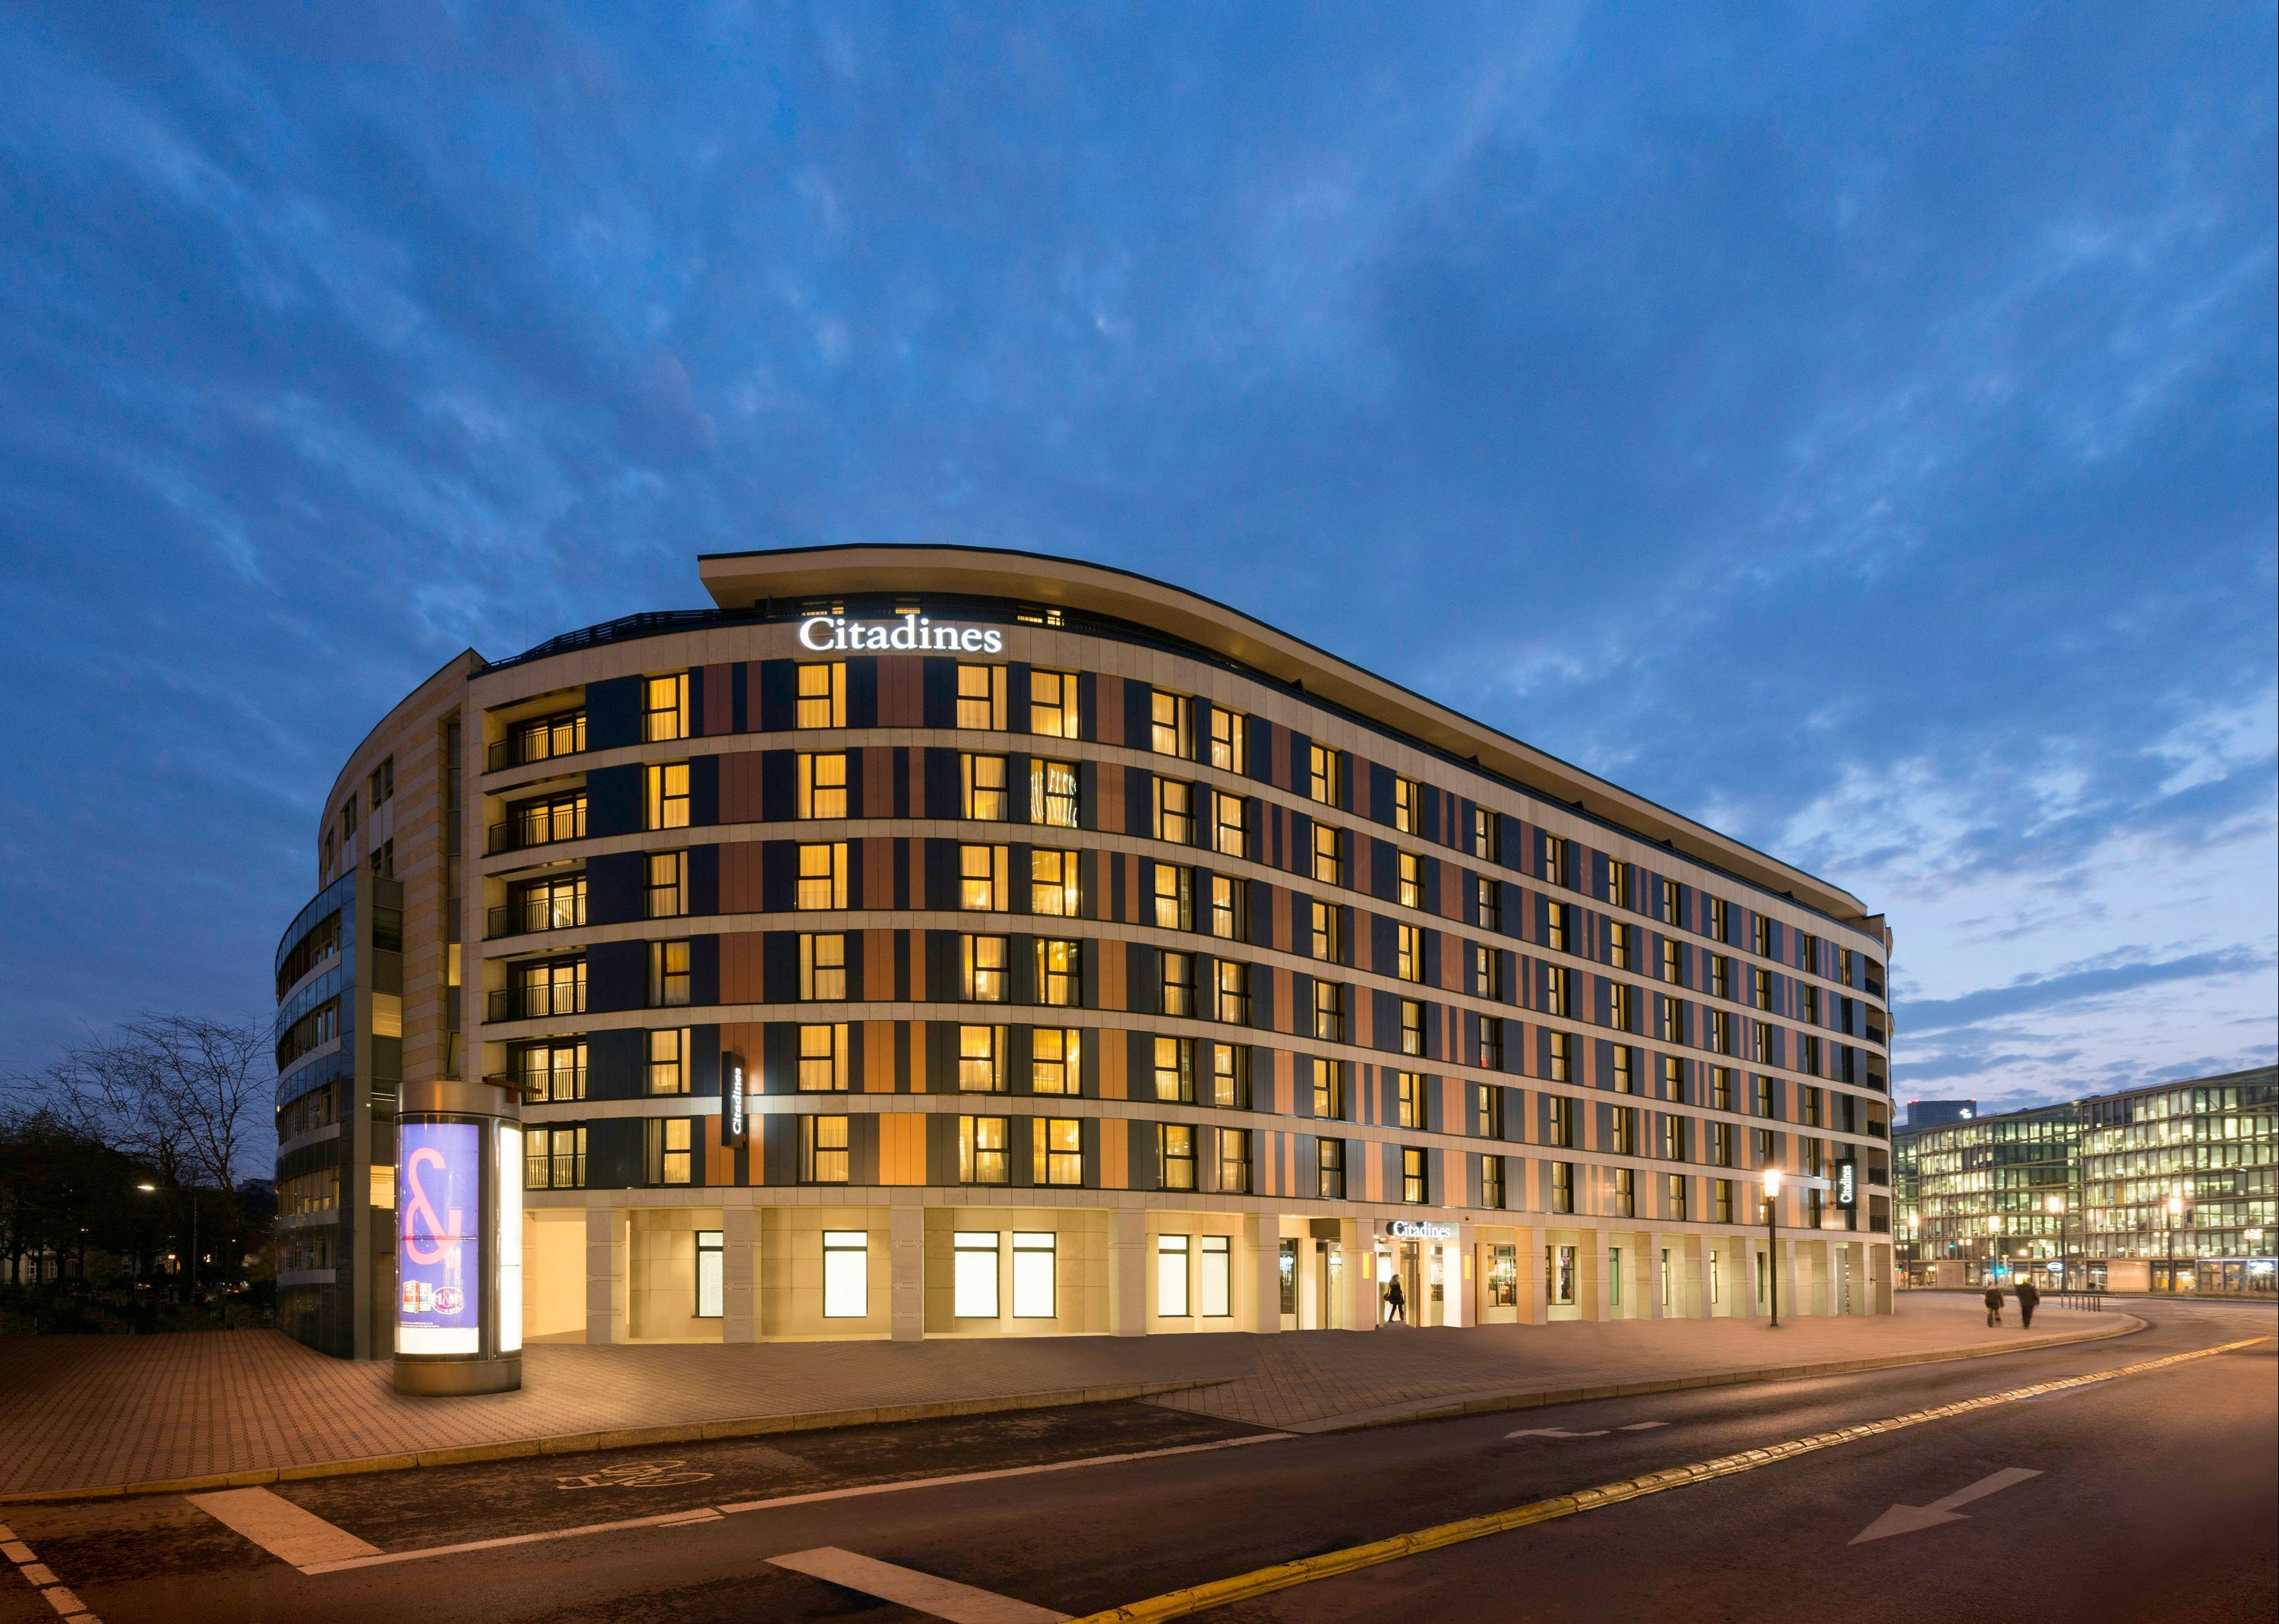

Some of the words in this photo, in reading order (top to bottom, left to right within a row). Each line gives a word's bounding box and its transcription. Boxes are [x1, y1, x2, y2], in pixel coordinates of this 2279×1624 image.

[799, 614, 1003, 654] Citadines
[732, 1066, 742, 1135] Citadines
[1839, 1164, 1853, 1203] Citadines
[405, 1147, 463, 1265] &
[1392, 1220, 1451, 1238] Citadines
[438, 1289, 459, 1308] L&M
